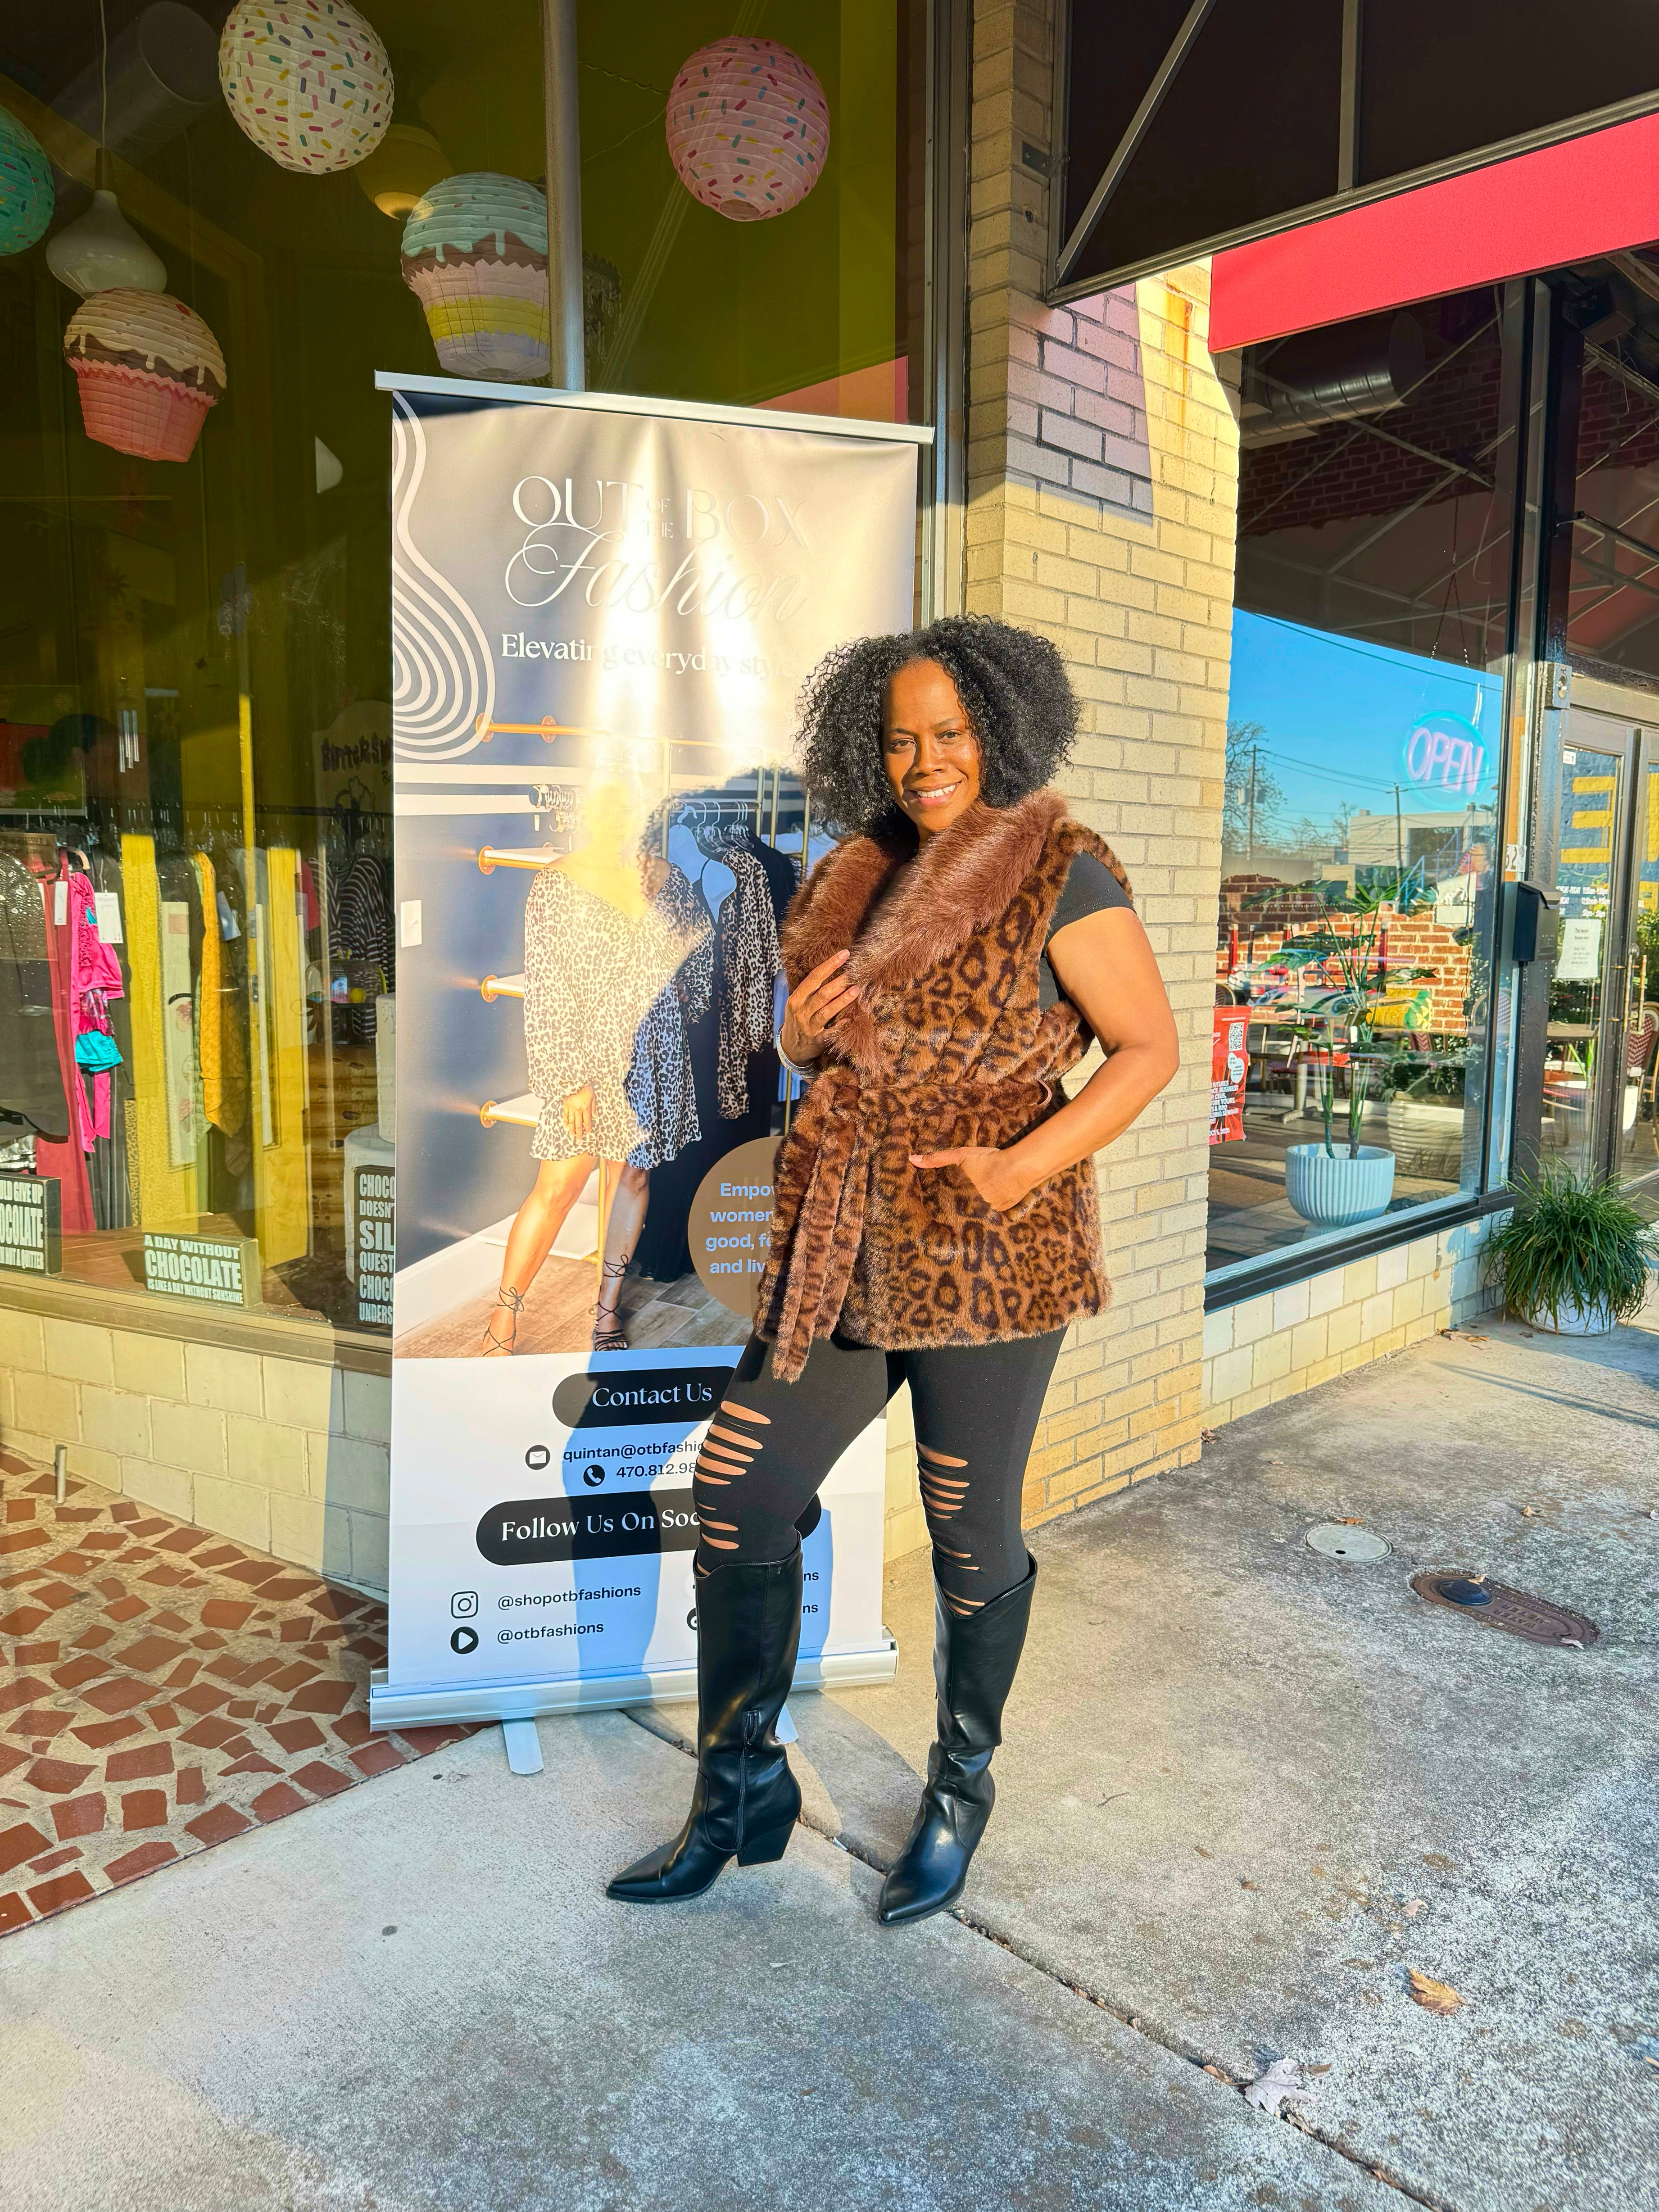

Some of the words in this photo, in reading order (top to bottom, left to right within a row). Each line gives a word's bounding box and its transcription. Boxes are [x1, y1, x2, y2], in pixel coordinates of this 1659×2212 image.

[512, 476, 644, 533] OUT
[647, 497, 670, 514] OF
[686, 489, 810, 549] BOX
[505, 522, 807, 622] Fashion
[501, 631, 619, 670] Elevating
[623, 646, 736, 679] everyday
[1407, 727, 1484, 796] OPEN
[14, 1181, 32, 1203] GIVE
[32, 1183, 44, 1204] UP
[360, 1173, 395, 1199] CHOCO
[721, 1183, 775, 1200] Empo
[359, 1200, 394, 1218] DOESN'
[710, 1210, 774, 1223] women
[0, 1203, 44, 1248] OCOLATE
[360, 1220, 394, 1251] SIL
[144, 1234, 154, 1247] A
[154, 1236, 178, 1250] DAY
[180, 1240, 240, 1259] WITHOUT
[706, 1233, 755, 1252] good,
[21, 1249, 45, 1269] QUITTER
[145, 1249, 242, 1290] CHOCOLATE
[359, 1251, 394, 1274] QUEST
[710, 1259, 742, 1274] and
[747, 1259, 766, 1274] liv
[147, 1278, 155, 1290] IS
[154, 1279, 168, 1292] LIKE
[167, 1281, 172, 1293] A
[172, 1282, 184, 1295] DAY
[184, 1284, 213, 1299] WITHOUT
[212, 1288, 244, 1304] SUNSHINE
[359, 1274, 394, 1303] CHOCO
[359, 1302, 393, 1325] UNDERS
[592, 1386, 681, 1407] Contact
[686, 1383, 712, 1402] Us
[616, 1462, 696, 1478] 470.812.98
[502, 1517, 580, 1541] Follow
[587, 1514, 614, 1533] Us
[621, 1512, 655, 1531] On
[661, 1509, 700, 1528] Soc
[498, 1586, 642, 1610] @shopotbfashions
[497, 1623, 604, 1644] @otbfashions
